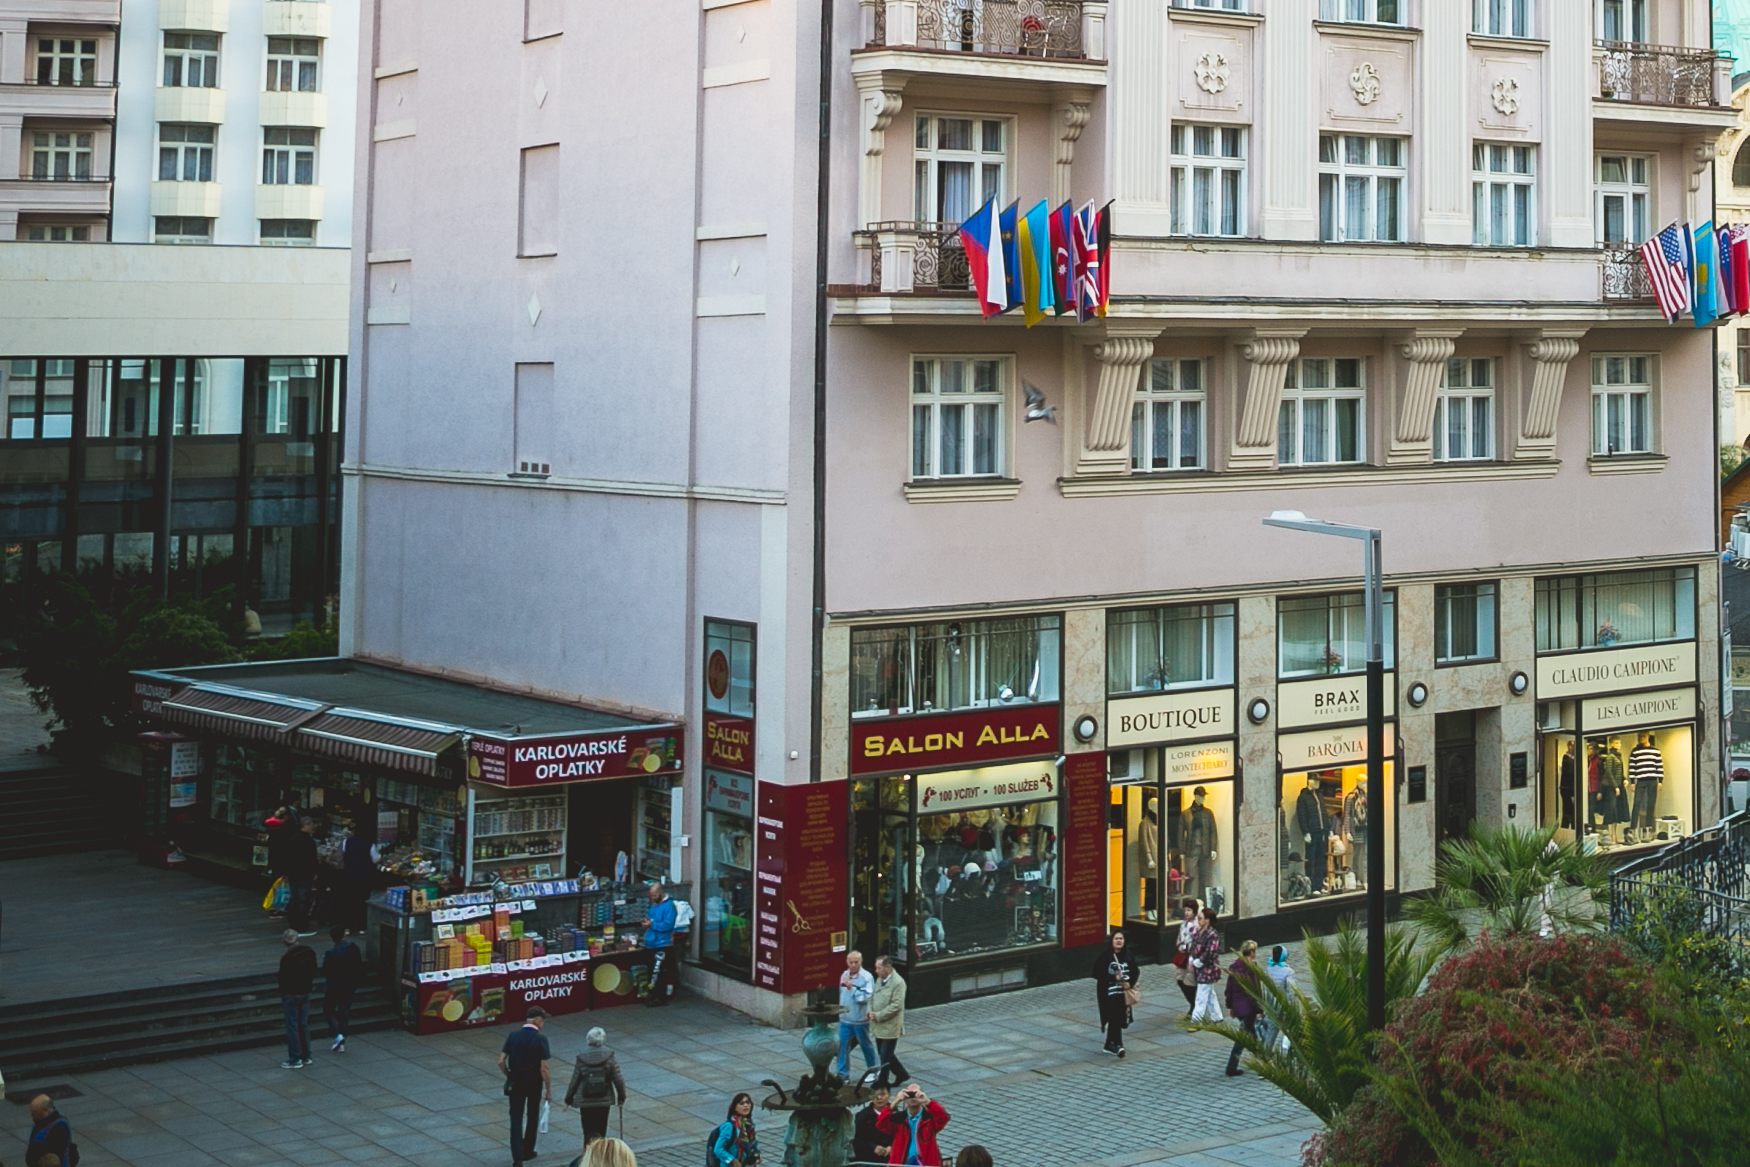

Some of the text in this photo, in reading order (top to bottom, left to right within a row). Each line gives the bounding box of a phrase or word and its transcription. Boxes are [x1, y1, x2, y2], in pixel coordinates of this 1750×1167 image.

[1552, 664, 1609, 685] CLAUDIO
[1314, 689, 1360, 708] BRAX
[1337, 705, 1360, 713] GOOD
[1597, 705, 1621, 721] LISA
[1120, 705, 1222, 733] BOUTIQUE
[707, 720, 750, 746] SALON
[864, 722, 1050, 758] SALON ALLA
[514, 735, 628, 763] KARLOVARSKÉ
[711, 739, 745, 762] ALLA
[1170, 747, 1229, 760] LORENZONI
[1307, 740, 1364, 758] BARONIA
[535, 759, 606, 780] OPLATKY
[1171, 759, 1229, 774] MONTECHIARO
[938, 786, 980, 803] 100 УСЛУГ
[992, 779, 1039, 796] 100 SLUŽEB
[509, 968, 587, 991] KARLOVARSKÉ
[524, 985, 574, 1002] OPLATKY
